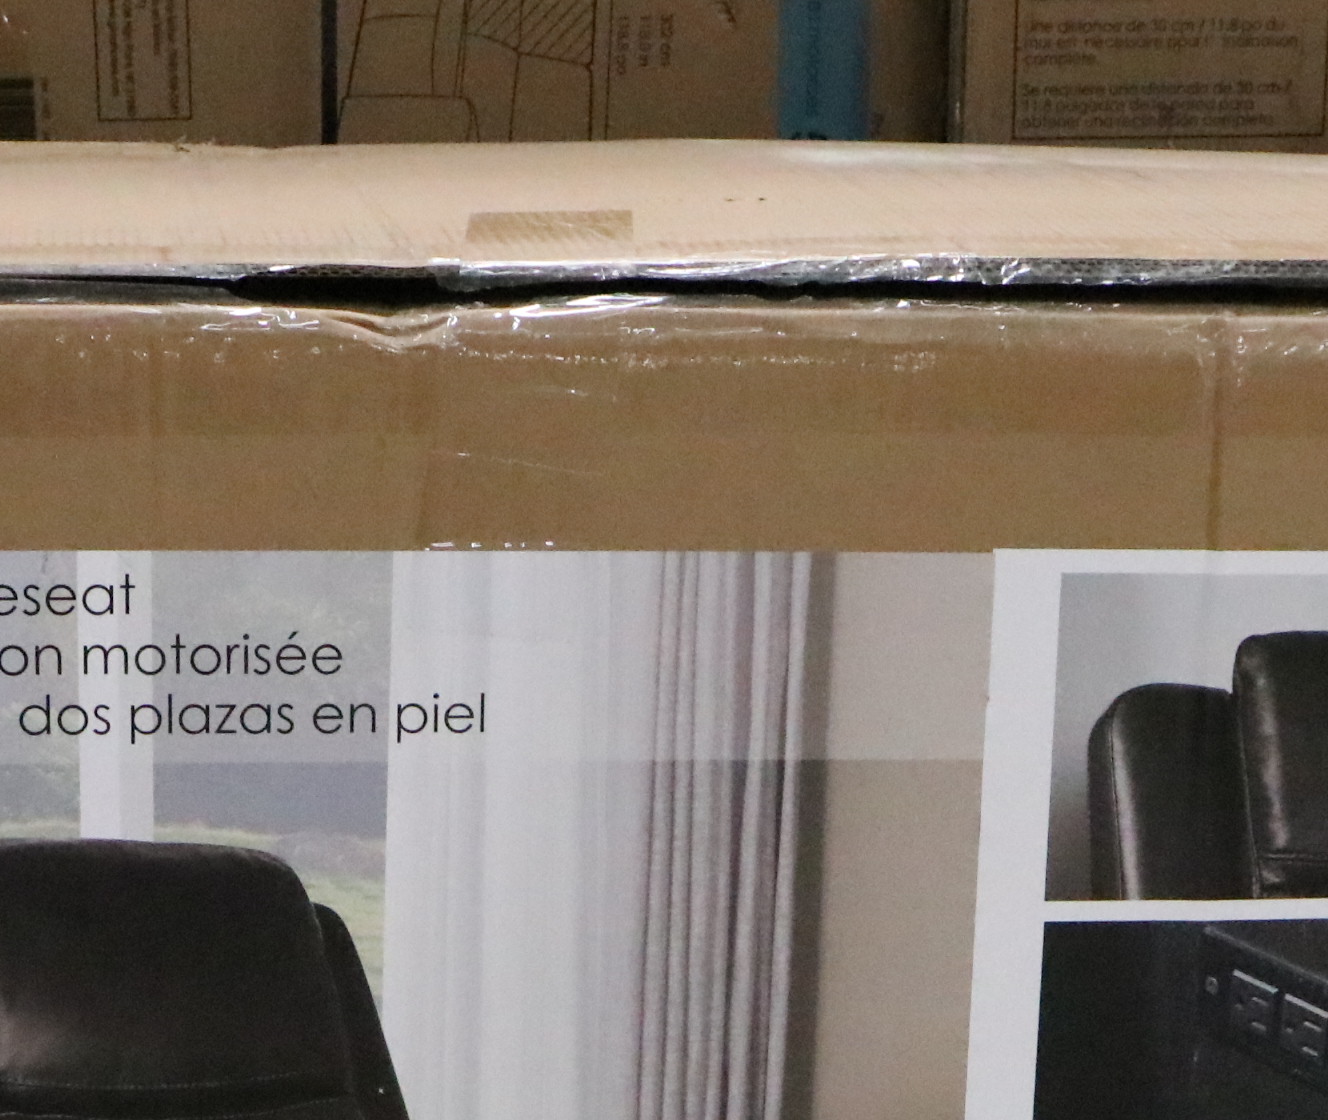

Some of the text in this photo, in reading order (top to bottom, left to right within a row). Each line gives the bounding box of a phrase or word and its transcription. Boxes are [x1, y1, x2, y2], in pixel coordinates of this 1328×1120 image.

[83, 631, 342, 676] motorisée
[19, 694, 111, 736] dos
[130, 694, 294, 745] plazas
[313, 703, 376, 734] en
[397, 693, 485, 743] piel
